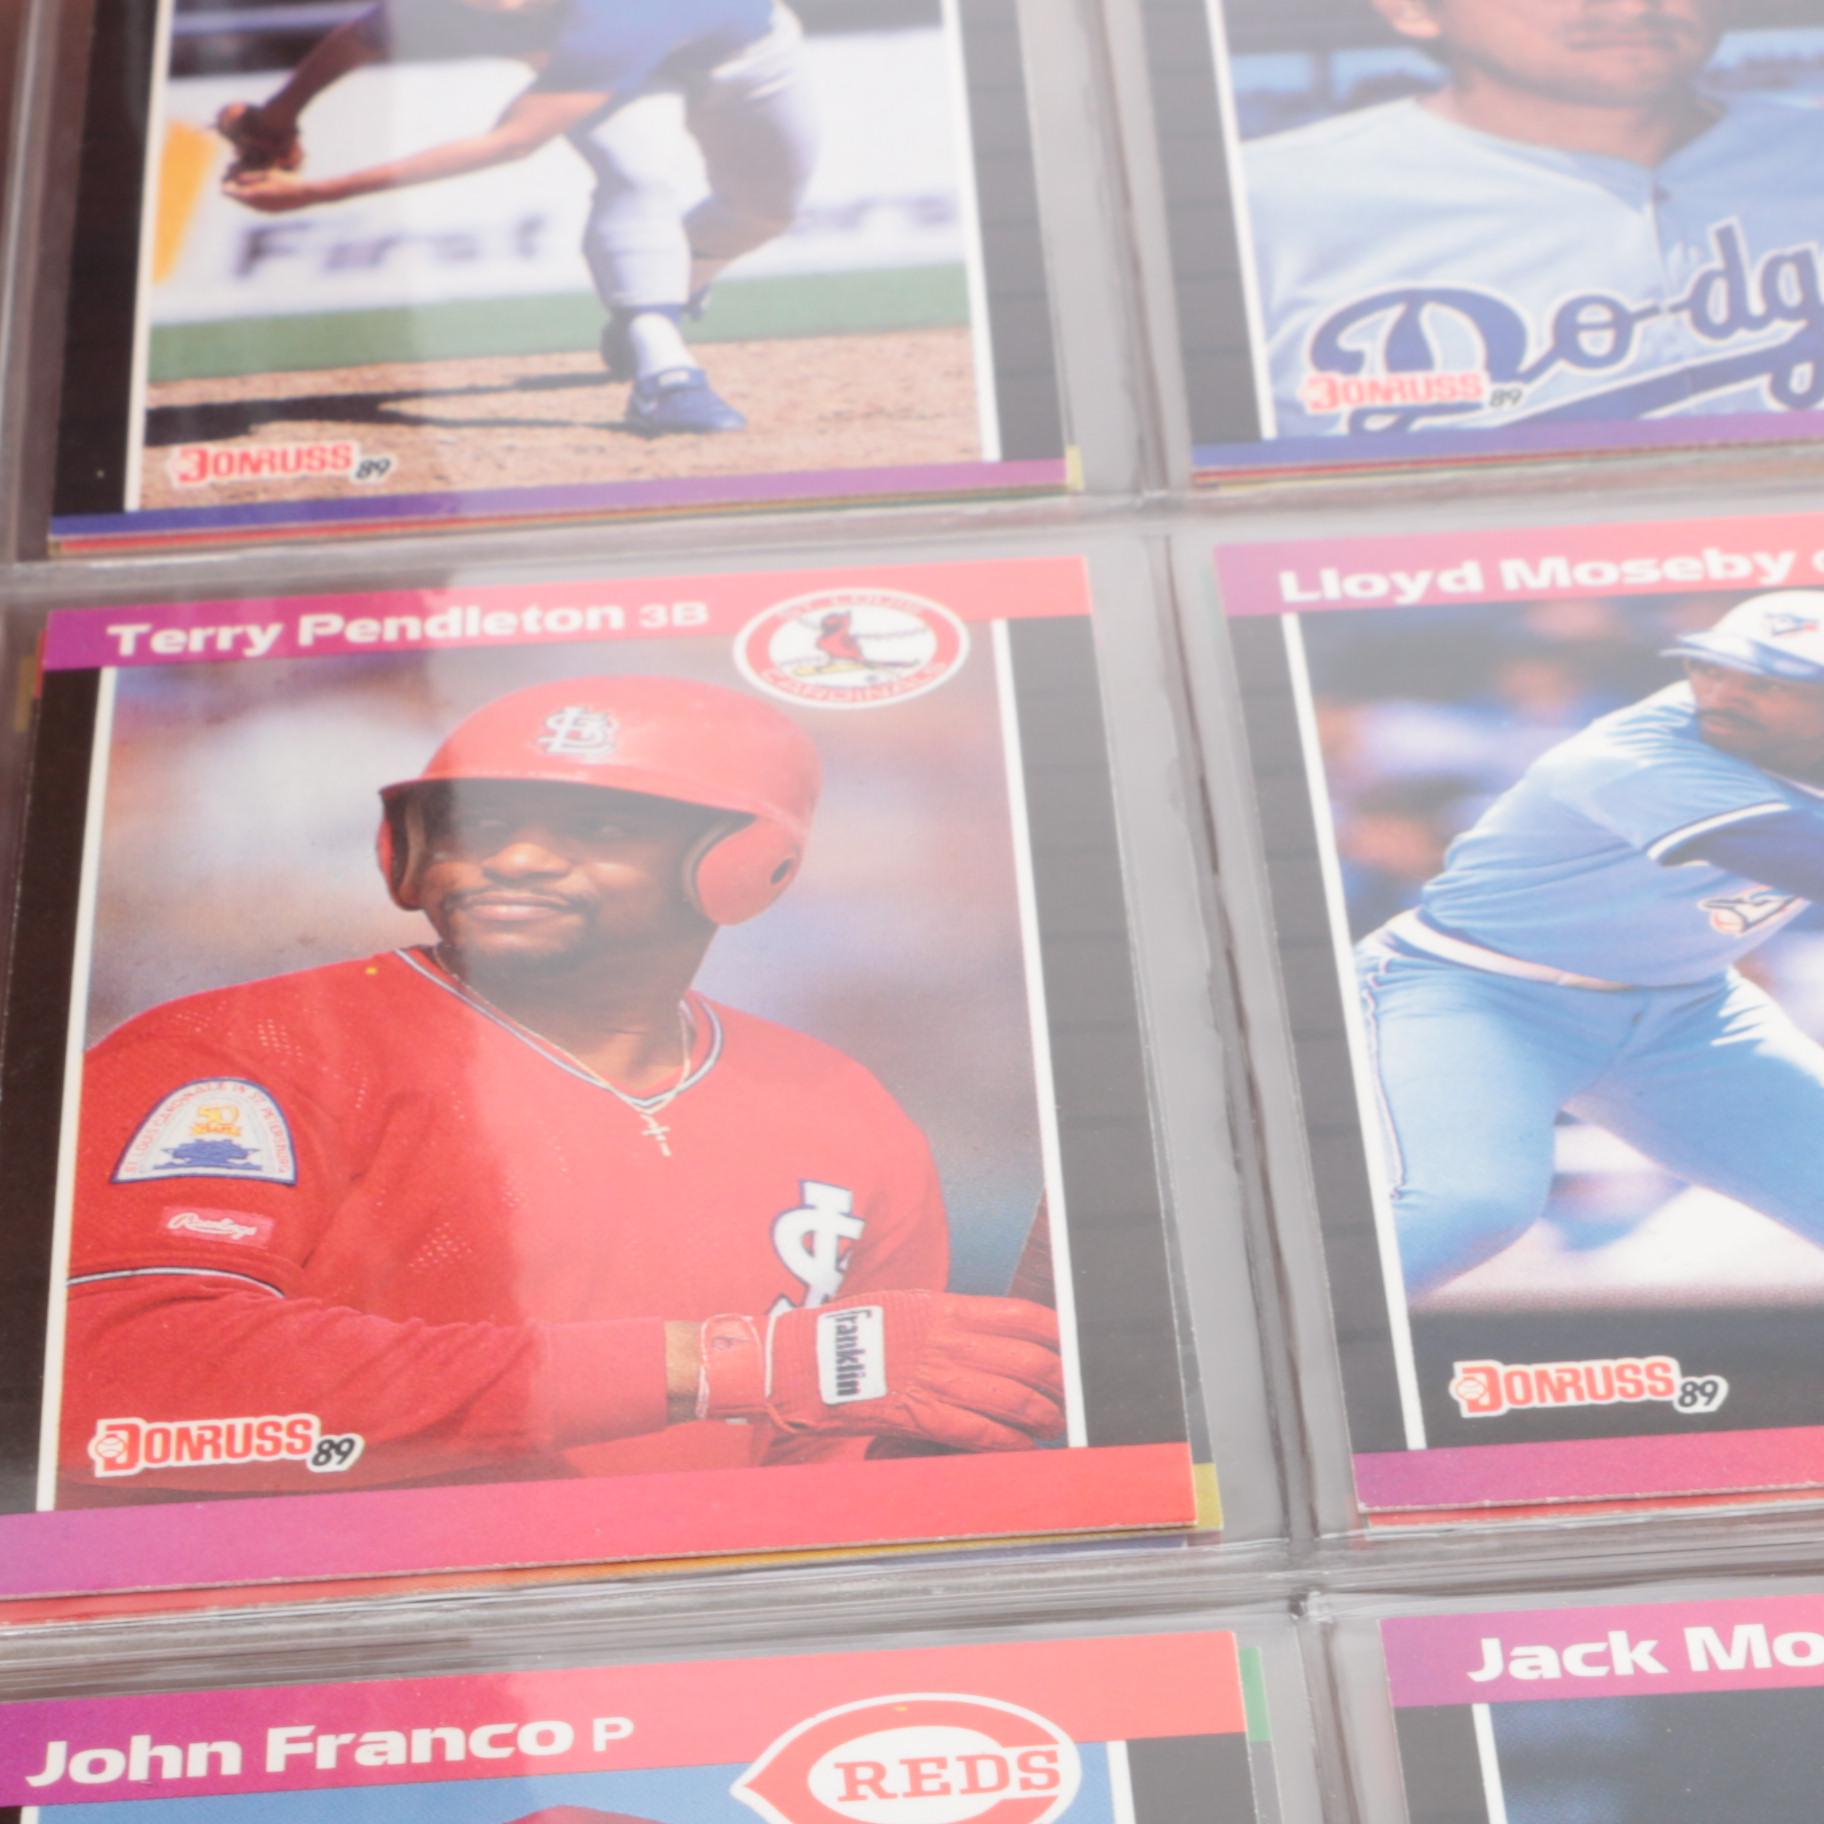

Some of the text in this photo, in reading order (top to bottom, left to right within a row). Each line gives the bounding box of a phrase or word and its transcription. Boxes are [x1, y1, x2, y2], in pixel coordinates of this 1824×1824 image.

[177, 444, 354, 482] DONRUSS
[1279, 561, 1484, 604] Lloyd
[1500, 547, 1797, 591] Moseby
[107, 601, 710, 657] Terry Pendleton 3B
[824, 1308, 873, 1397] Franklin
[1456, 1361, 1719, 1414] DONRUSS 89
[95, 1418, 355, 1472] DONRUSS 89
[1466, 1630, 1669, 1683] Jack
[25, 1715, 635, 1789] John Franco P
[835, 1744, 1063, 1802] REDS
